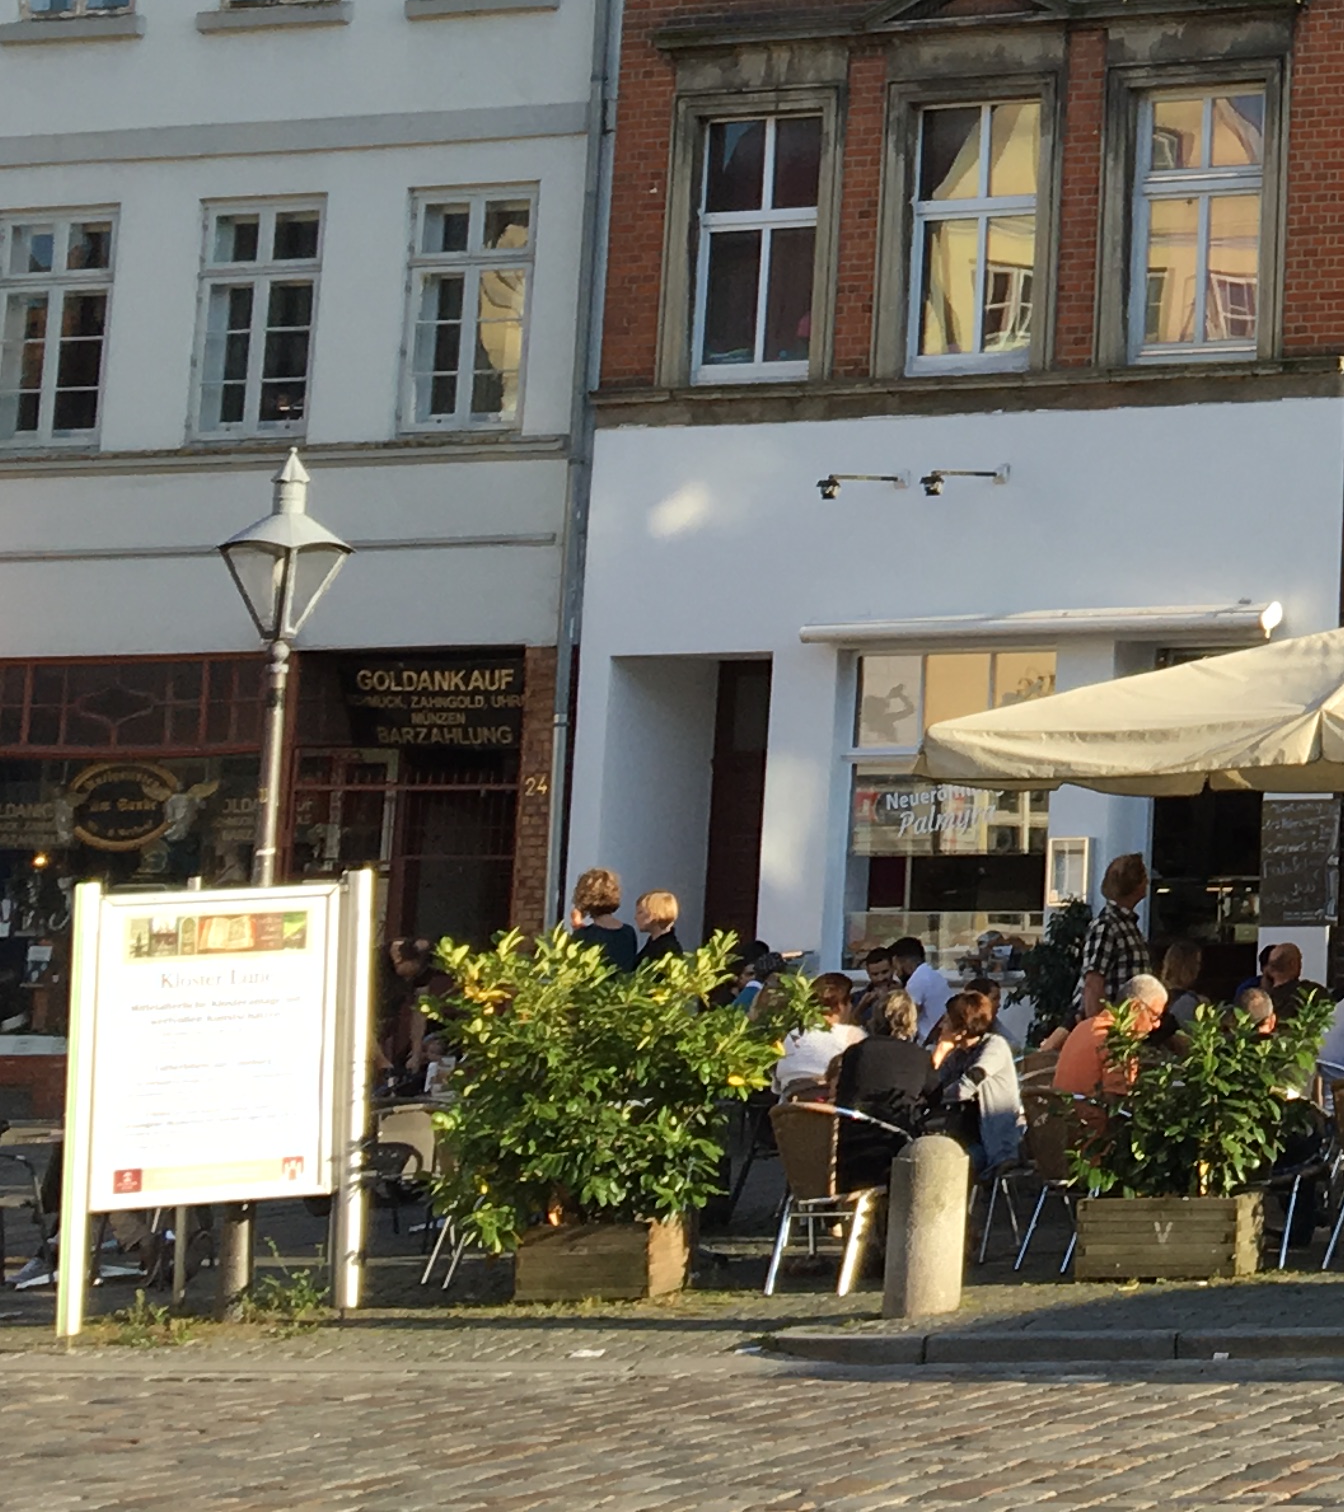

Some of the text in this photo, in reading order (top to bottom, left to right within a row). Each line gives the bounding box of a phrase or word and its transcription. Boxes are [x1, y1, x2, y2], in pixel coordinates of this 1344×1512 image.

[356, 669, 515, 692] GOLDANKAUF
[411, 710, 466, 725] MÜNZEN
[376, 725, 513, 745] BARZAHLUNG
[524, 774, 548, 796] 24
